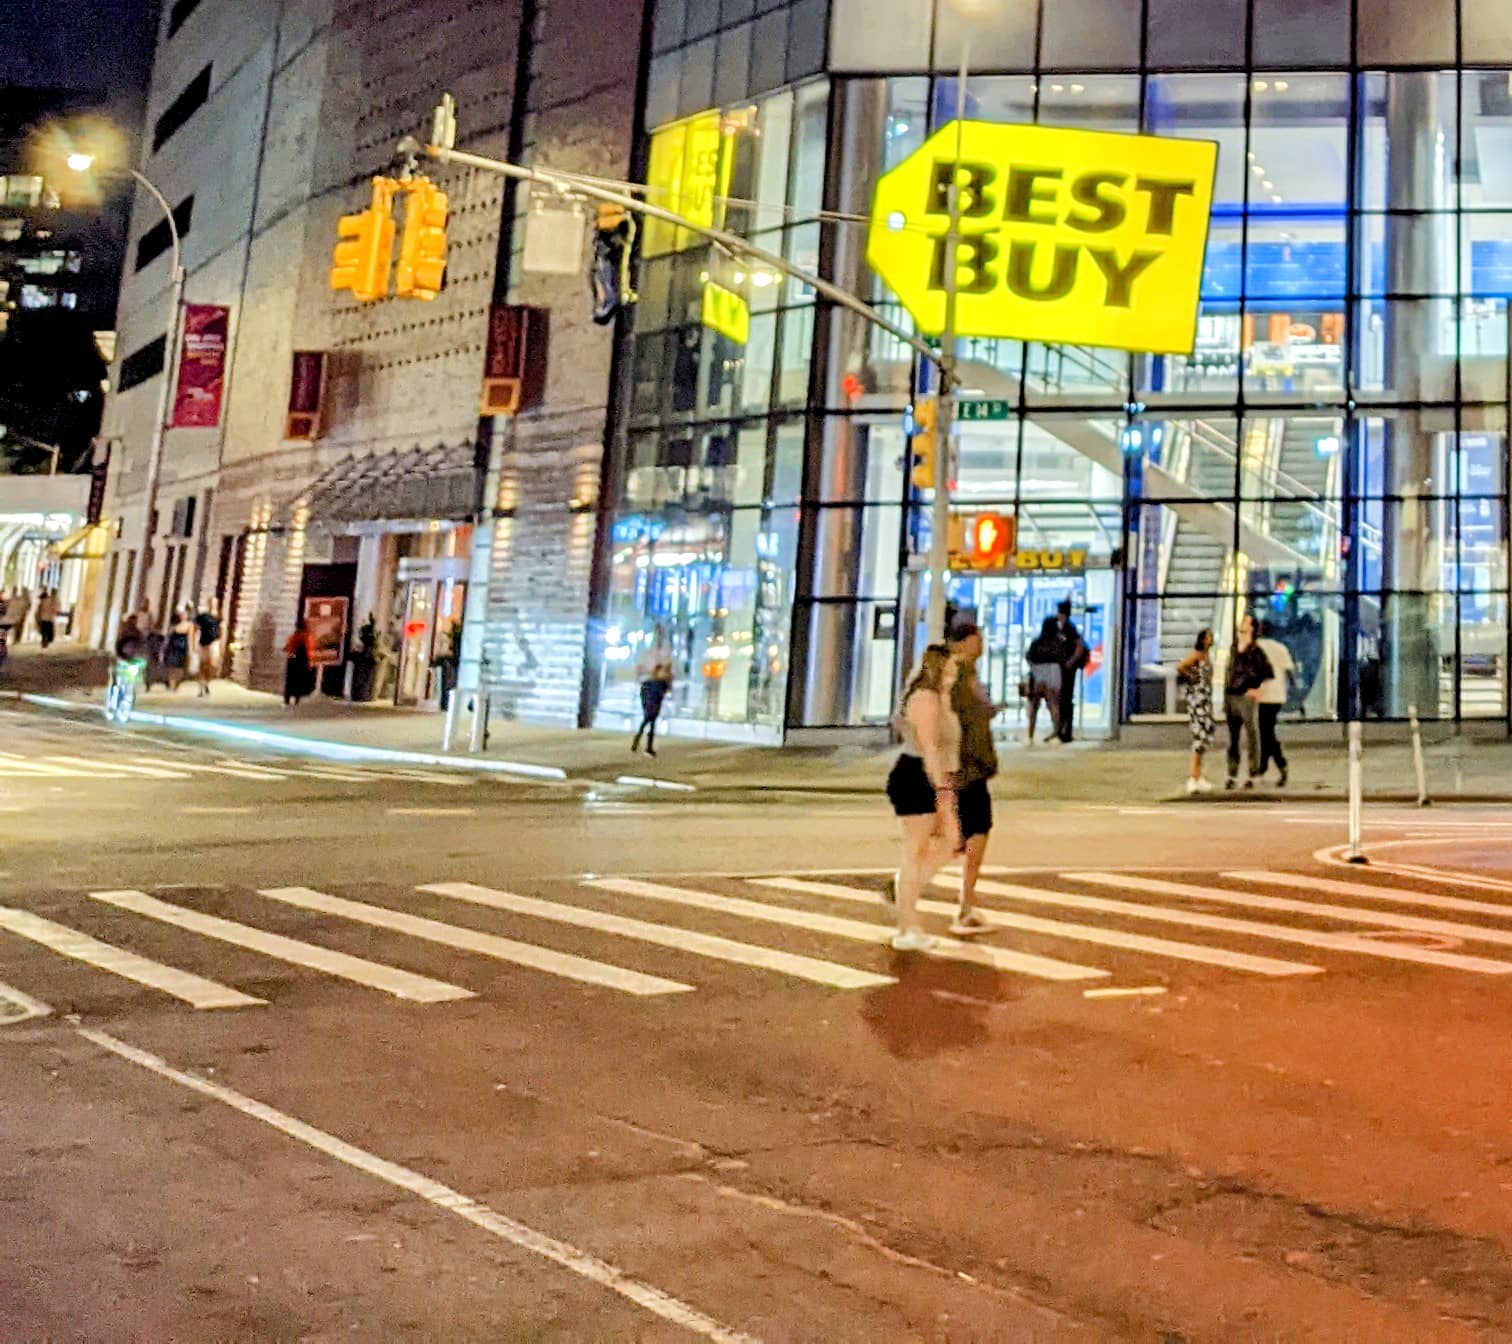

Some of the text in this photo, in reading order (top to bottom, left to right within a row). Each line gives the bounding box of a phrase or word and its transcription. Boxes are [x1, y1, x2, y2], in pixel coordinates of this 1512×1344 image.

[925, 160, 1196, 237] BEST
[926, 230, 1166, 309] BUY
[962, 403, 971, 418] E
[1016, 550, 1086, 569] BUY
